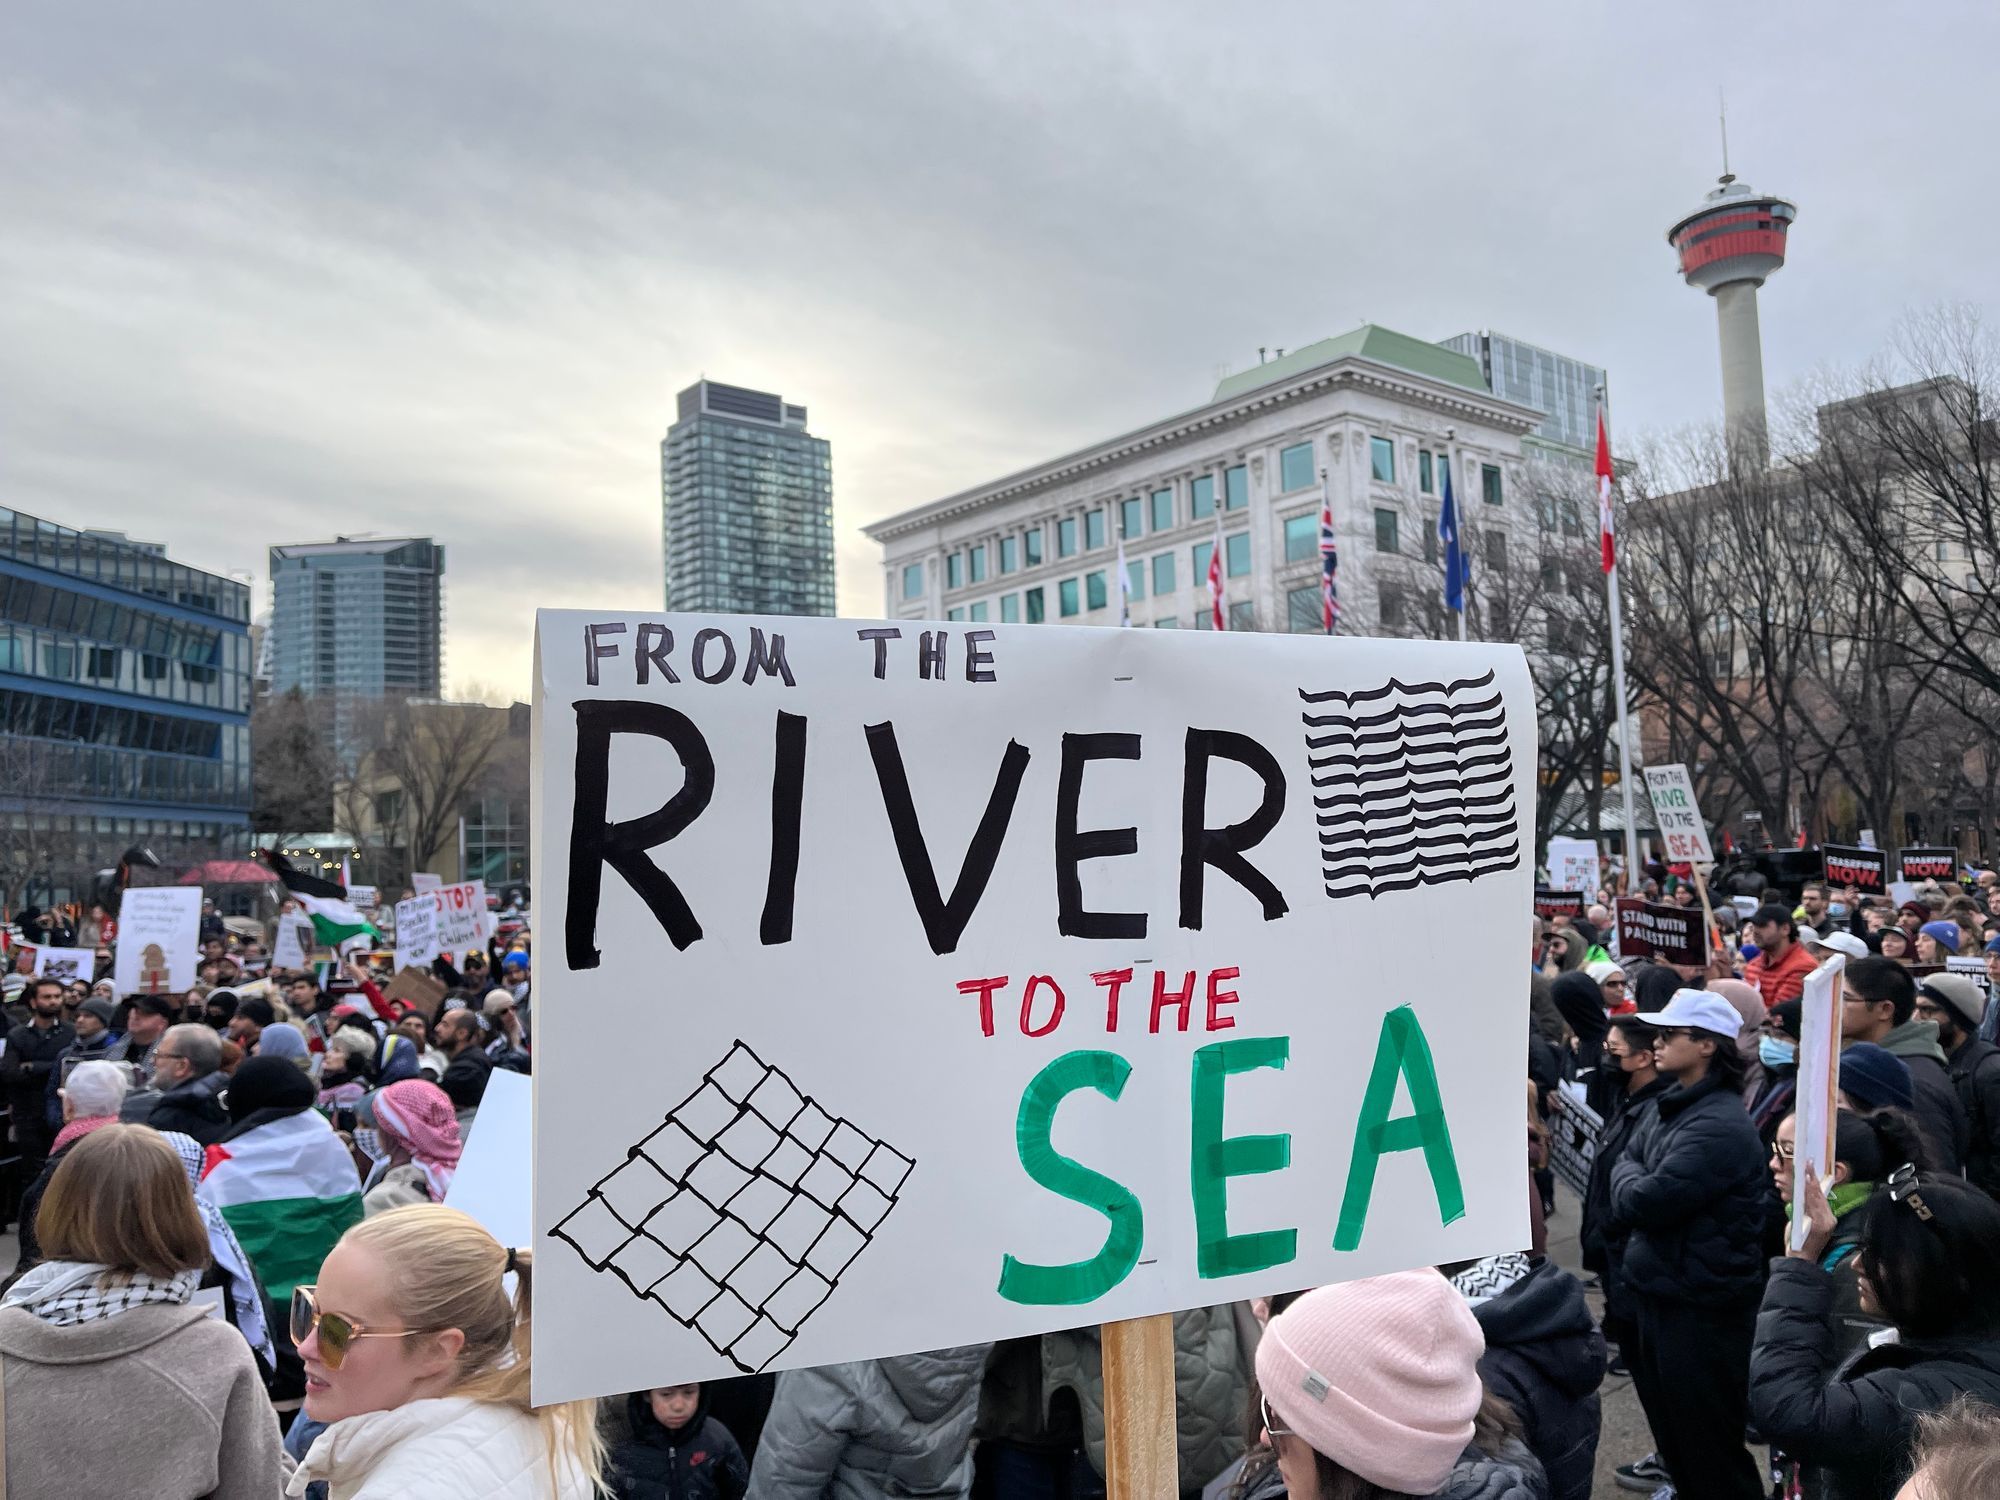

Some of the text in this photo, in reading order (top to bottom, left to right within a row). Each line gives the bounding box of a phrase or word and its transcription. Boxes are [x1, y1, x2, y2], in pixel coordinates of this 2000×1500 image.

[584, 622, 997, 687] FROM THE
[1647, 771, 1684, 786] FROM THE
[1652, 788, 1689, 808] RIVER
[1659, 812, 1695, 828] TO THE
[565, 700, 1290, 971] RIVER
[1668, 834, 1705, 856] SEA
[1827, 856, 1880, 871] CEASEFIRE
[433, 885, 474, 912] STOP
[1622, 910, 1687, 933] STAND WITH
[1624, 926, 1688, 949] PALESTINE
[956, 967, 1240, 1037] TO THE
[997, 1002, 1466, 1305] SEA
